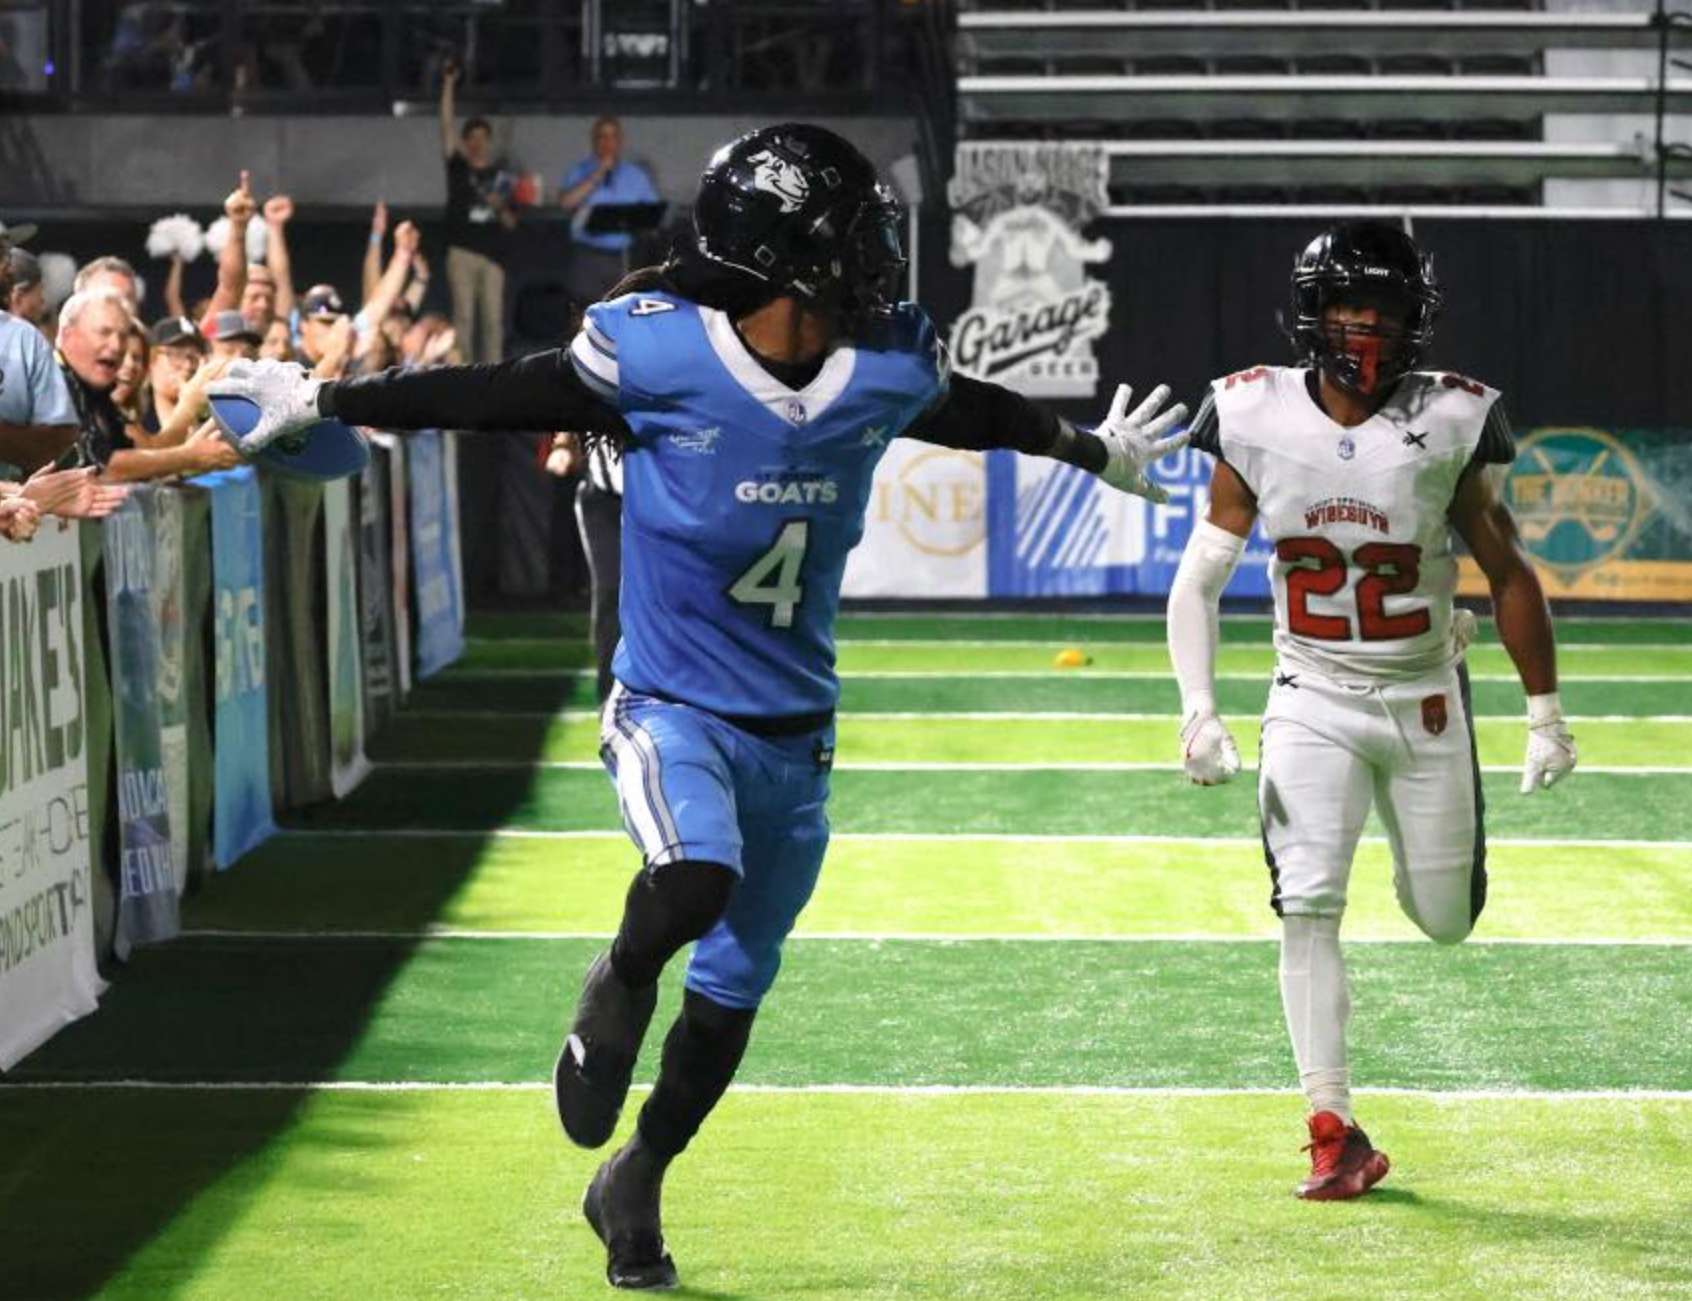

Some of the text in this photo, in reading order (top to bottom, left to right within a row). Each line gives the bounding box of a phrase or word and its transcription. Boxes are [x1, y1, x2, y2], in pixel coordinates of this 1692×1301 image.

[956, 286, 1103, 367] Garage
[735, 481, 839, 505] GOATS
[727, 521, 809, 628] 4
[1274, 537, 1431, 642] 22
